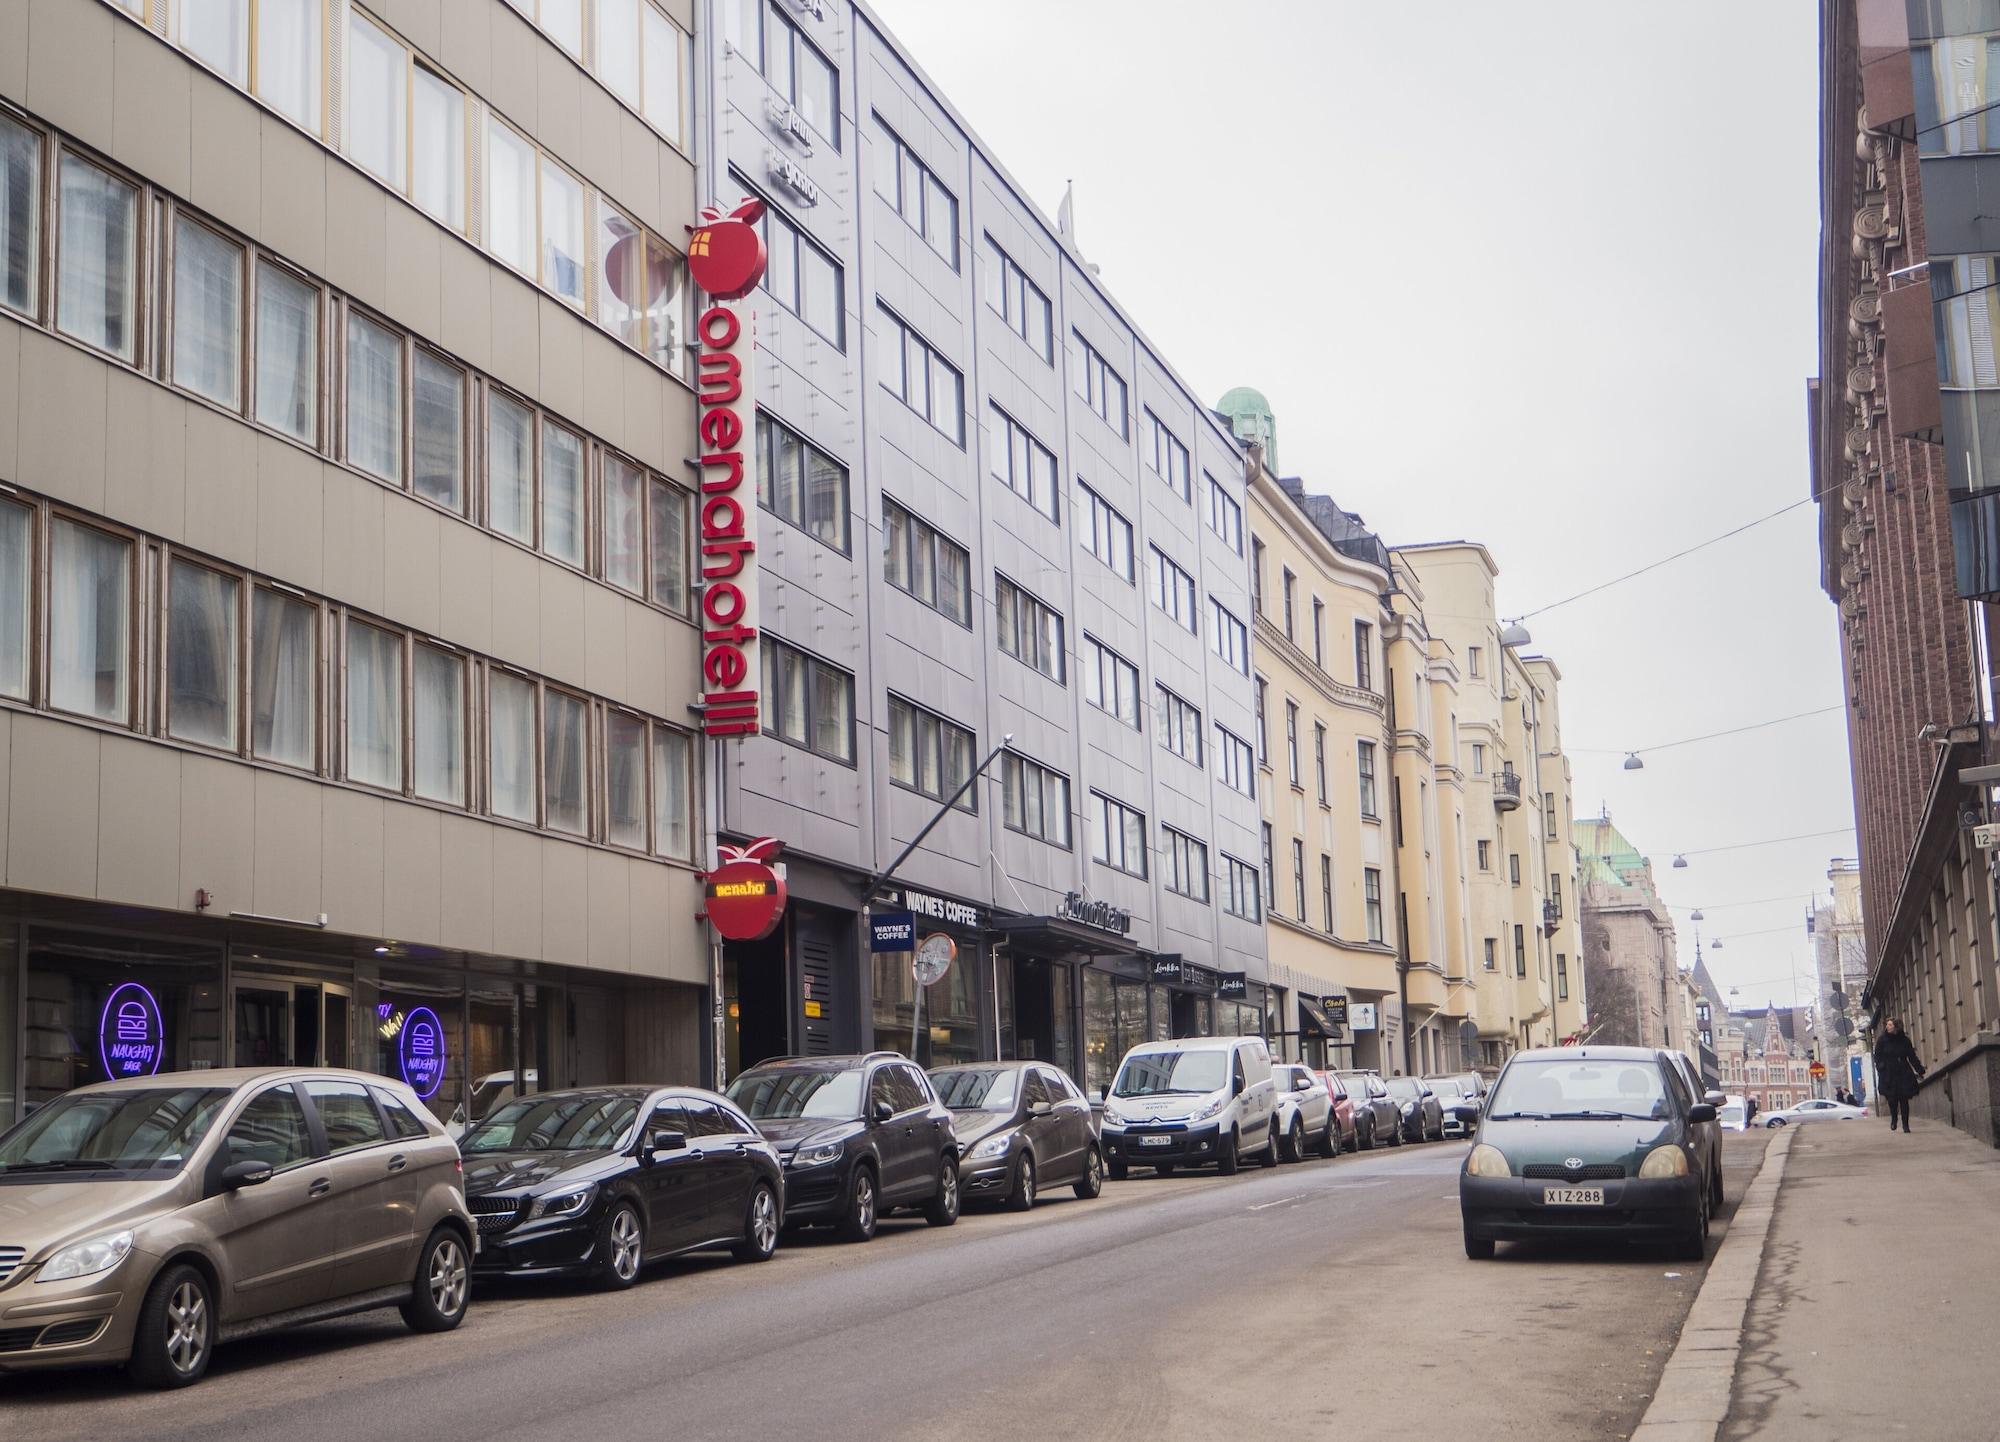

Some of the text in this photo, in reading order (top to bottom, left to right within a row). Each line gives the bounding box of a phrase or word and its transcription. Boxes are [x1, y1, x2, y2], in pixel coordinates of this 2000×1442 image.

[699, 306, 759, 736] omenahotelli
[1977, 833, 1990, 845] 12
[904, 890, 977, 927] WAYNE'S COFFEE
[874, 924, 911, 933] WAYNE'S
[876, 931, 909, 940] COFFEE
[111, 1043, 154, 1063] NAUGHTY
[408, 1057, 439, 1074] NAUGHTY
[1548, 1190, 1600, 1202] XIZ-288
